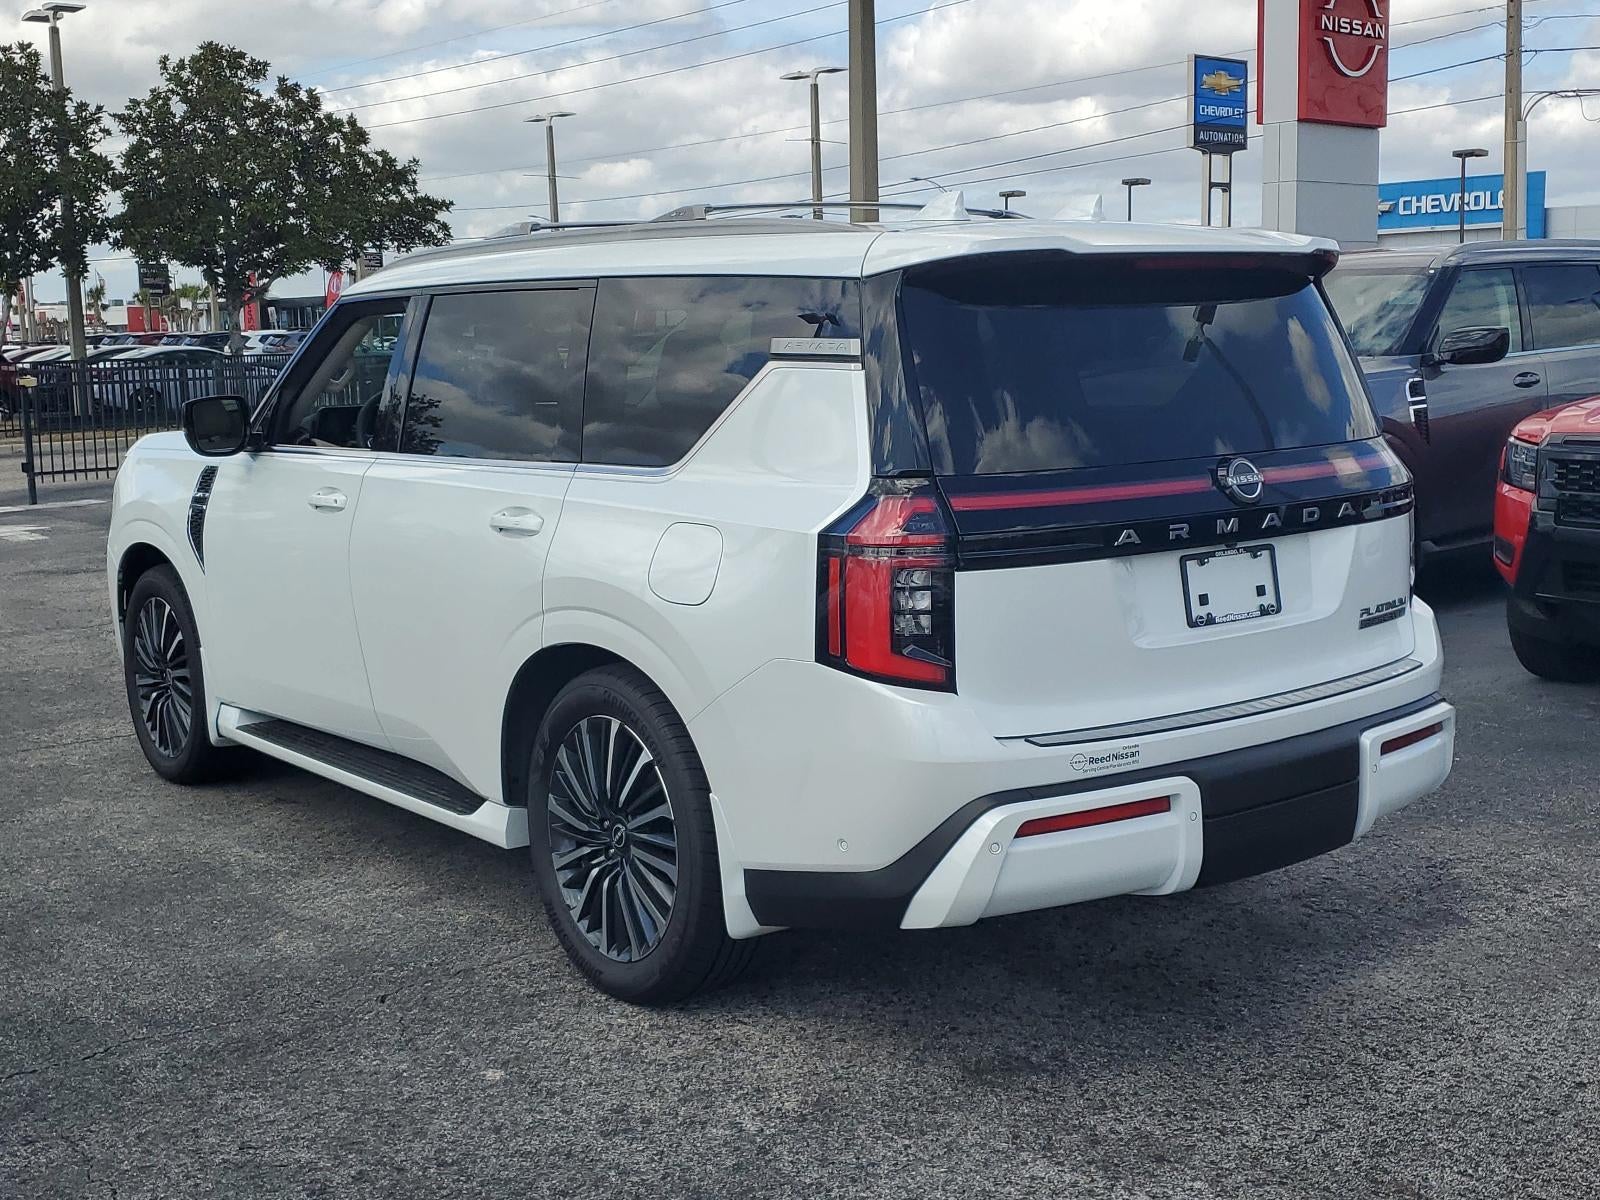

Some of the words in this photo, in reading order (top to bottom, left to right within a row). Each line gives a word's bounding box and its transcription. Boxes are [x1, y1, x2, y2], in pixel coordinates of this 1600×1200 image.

[1321, 14, 1385, 39] NISSAN
[1200, 104, 1244, 119] CHEVROLET
[1200, 130, 1245, 143] AUTONATION
[1398, 189, 1504, 215] CHEVROL
[1227, 472, 1264, 486] NISSAN
[1114, 502, 1356, 547] ARMADA
[1360, 596, 1407, 618] PLATINUM
[1215, 611, 1260, 623] ReedNissan.com
[1088, 753, 1111, 766] Reed
[1112, 750, 1140, 761] Nissan
